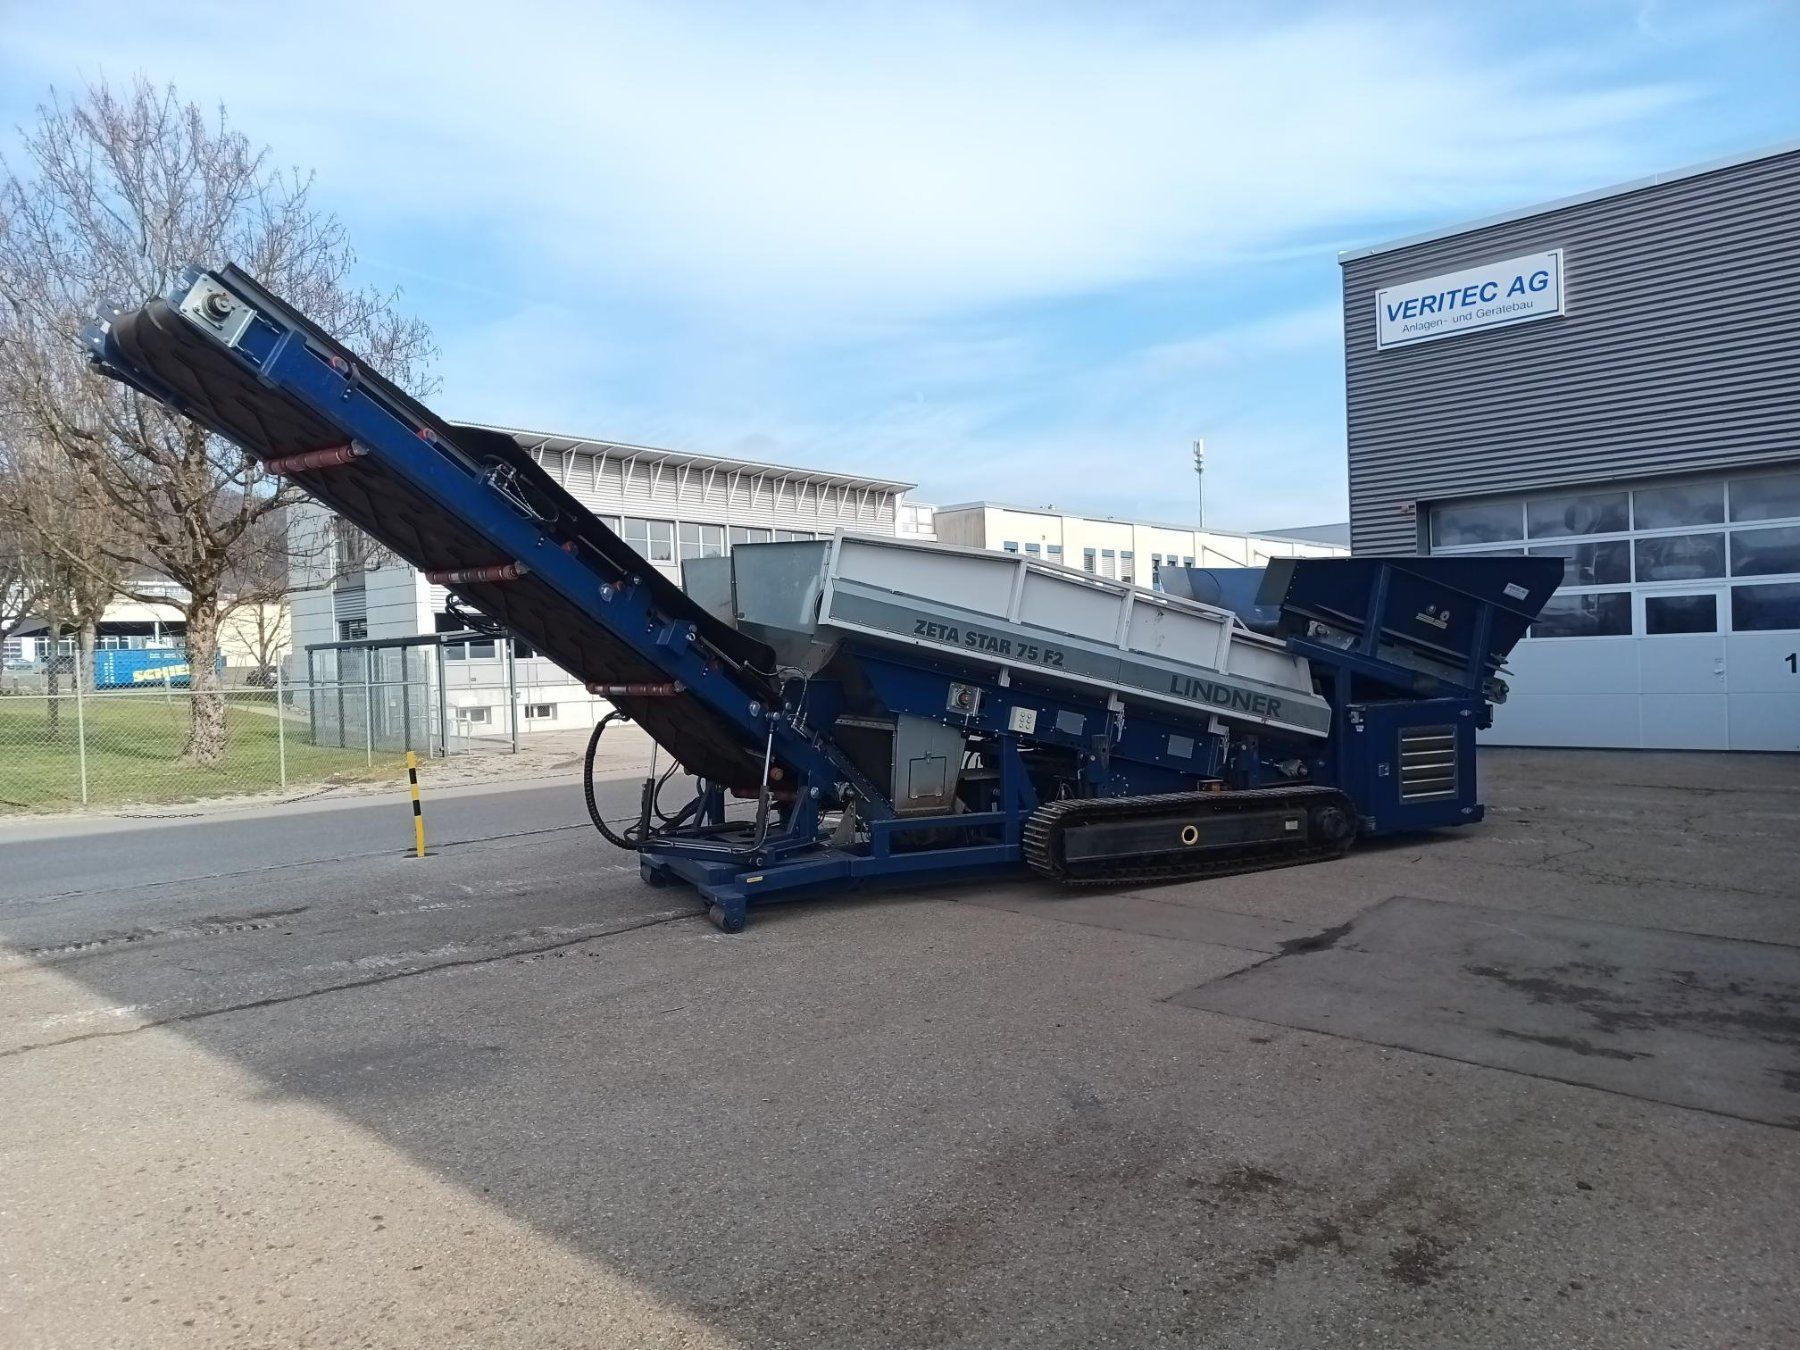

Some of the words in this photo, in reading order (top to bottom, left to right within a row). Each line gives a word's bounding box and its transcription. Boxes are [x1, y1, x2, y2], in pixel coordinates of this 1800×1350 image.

[1387, 281, 1498, 322] VERITEC
[1506, 270, 1549, 298] AG
[1402, 318, 1448, 333] Anlagen-
[1453, 312, 1473, 324] und
[1476, 300, 1534, 319] Gerätebau
[914, 619, 959, 643] ZETA
[965, 631, 1011, 655] STAR
[1017, 643, 1038, 661] 75
[1043, 650, 1064, 666] F2
[1785, 652, 1797, 674] 1
[1170, 675, 1282, 718] LINDNER
